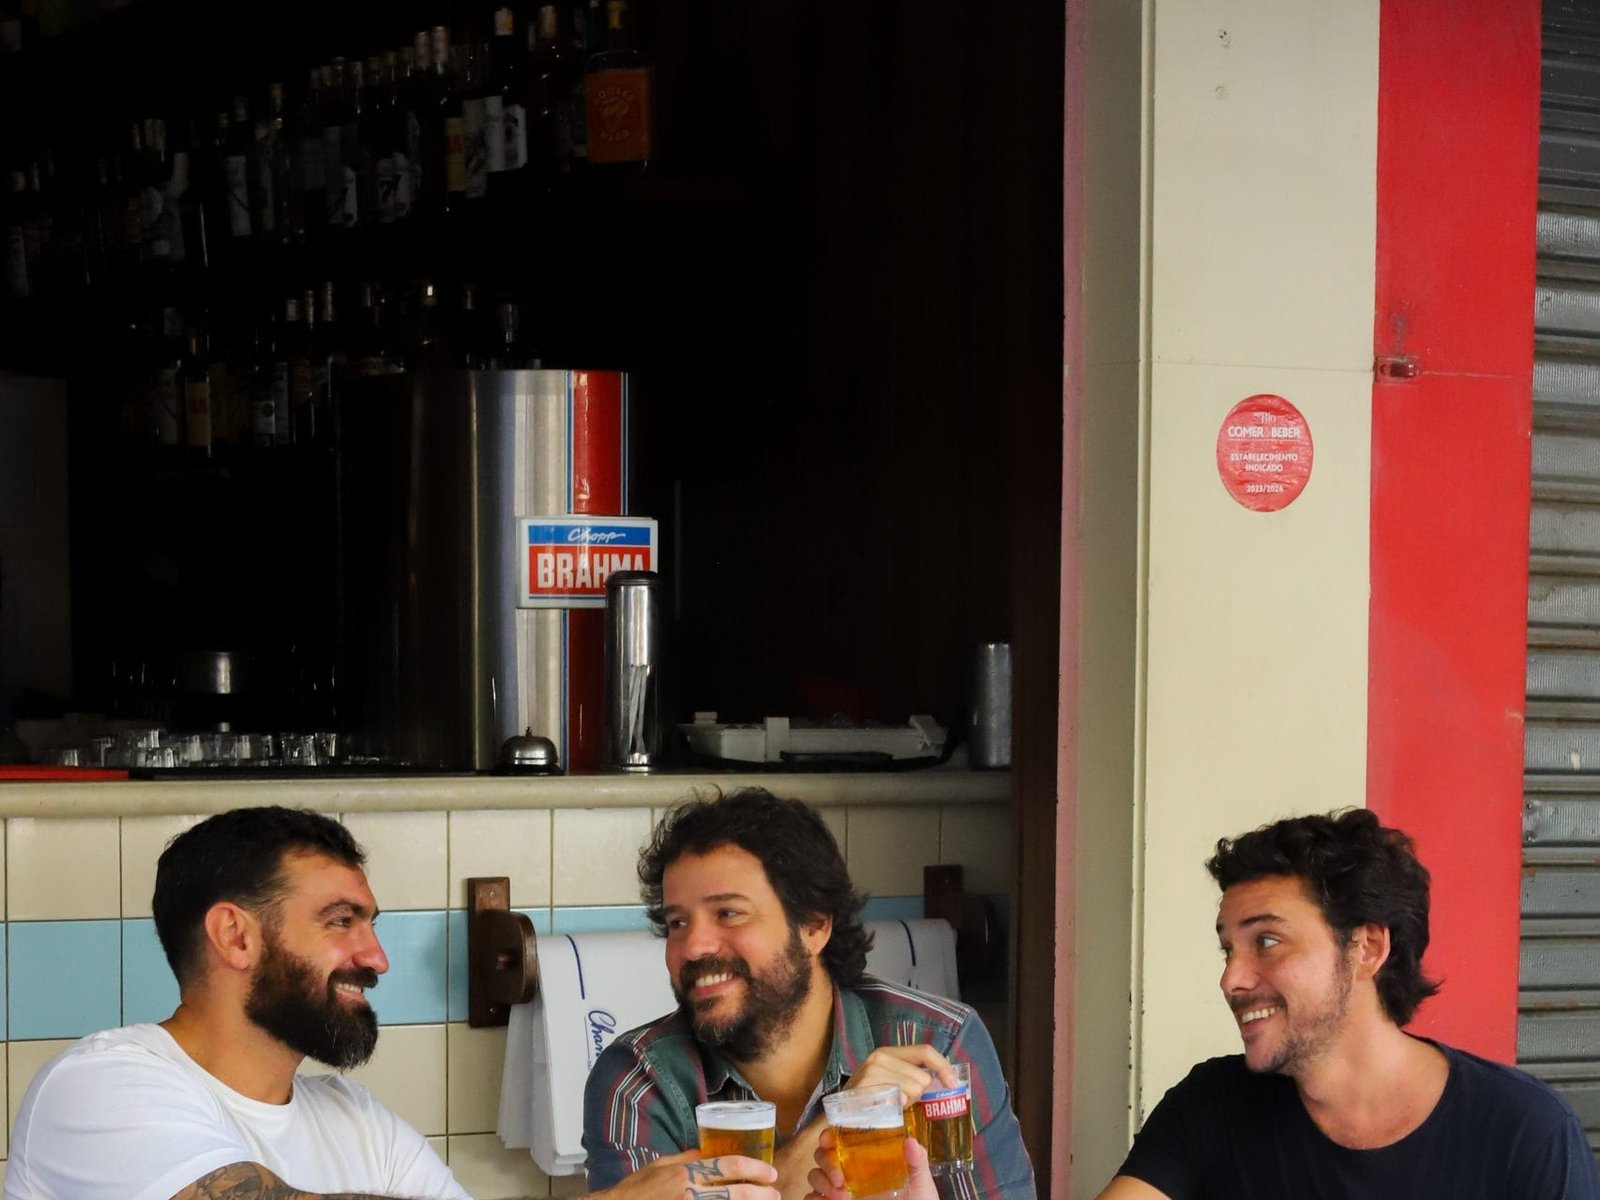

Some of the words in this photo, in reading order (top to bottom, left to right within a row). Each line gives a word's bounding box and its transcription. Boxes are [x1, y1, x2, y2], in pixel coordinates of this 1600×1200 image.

[1228, 427, 1263, 437] COMER
[1271, 427, 1300, 437] BEBER
[568, 527, 626, 543] Chopp
[925, 1097, 967, 1117] BRAHMA
